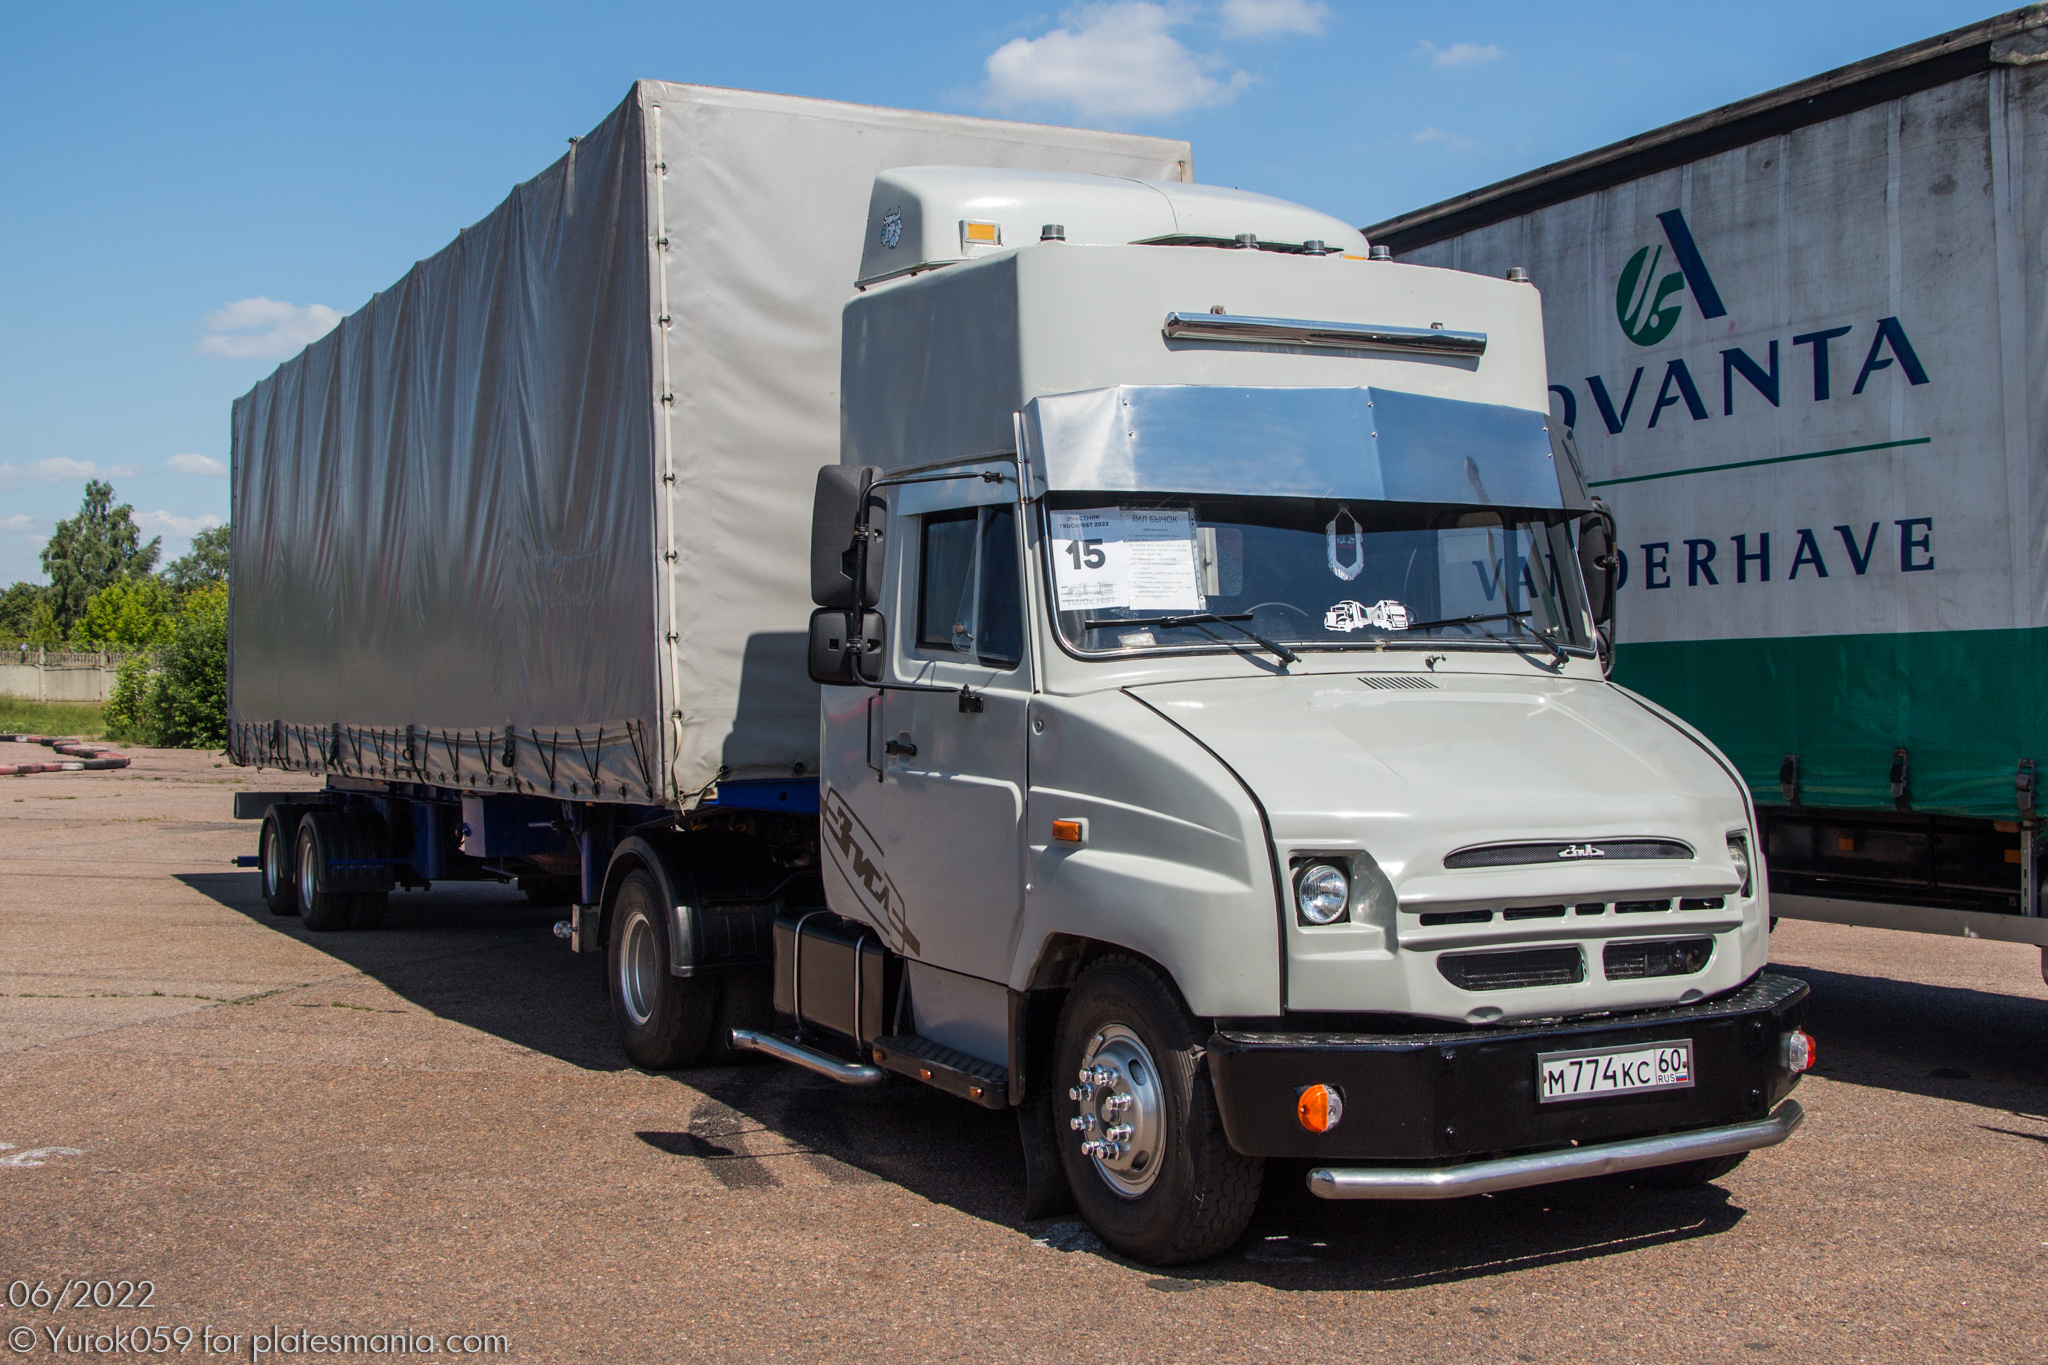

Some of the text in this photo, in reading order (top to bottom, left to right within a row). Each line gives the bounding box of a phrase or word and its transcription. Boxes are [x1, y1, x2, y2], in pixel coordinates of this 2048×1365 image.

[1131, 515, 1178, 523] ЗИЛ БЫЧОК
[1065, 538, 1106, 570] 15
[1548, 1048, 1682, 1095] М774КС 60
[1657, 1073, 1676, 1084] RUS
